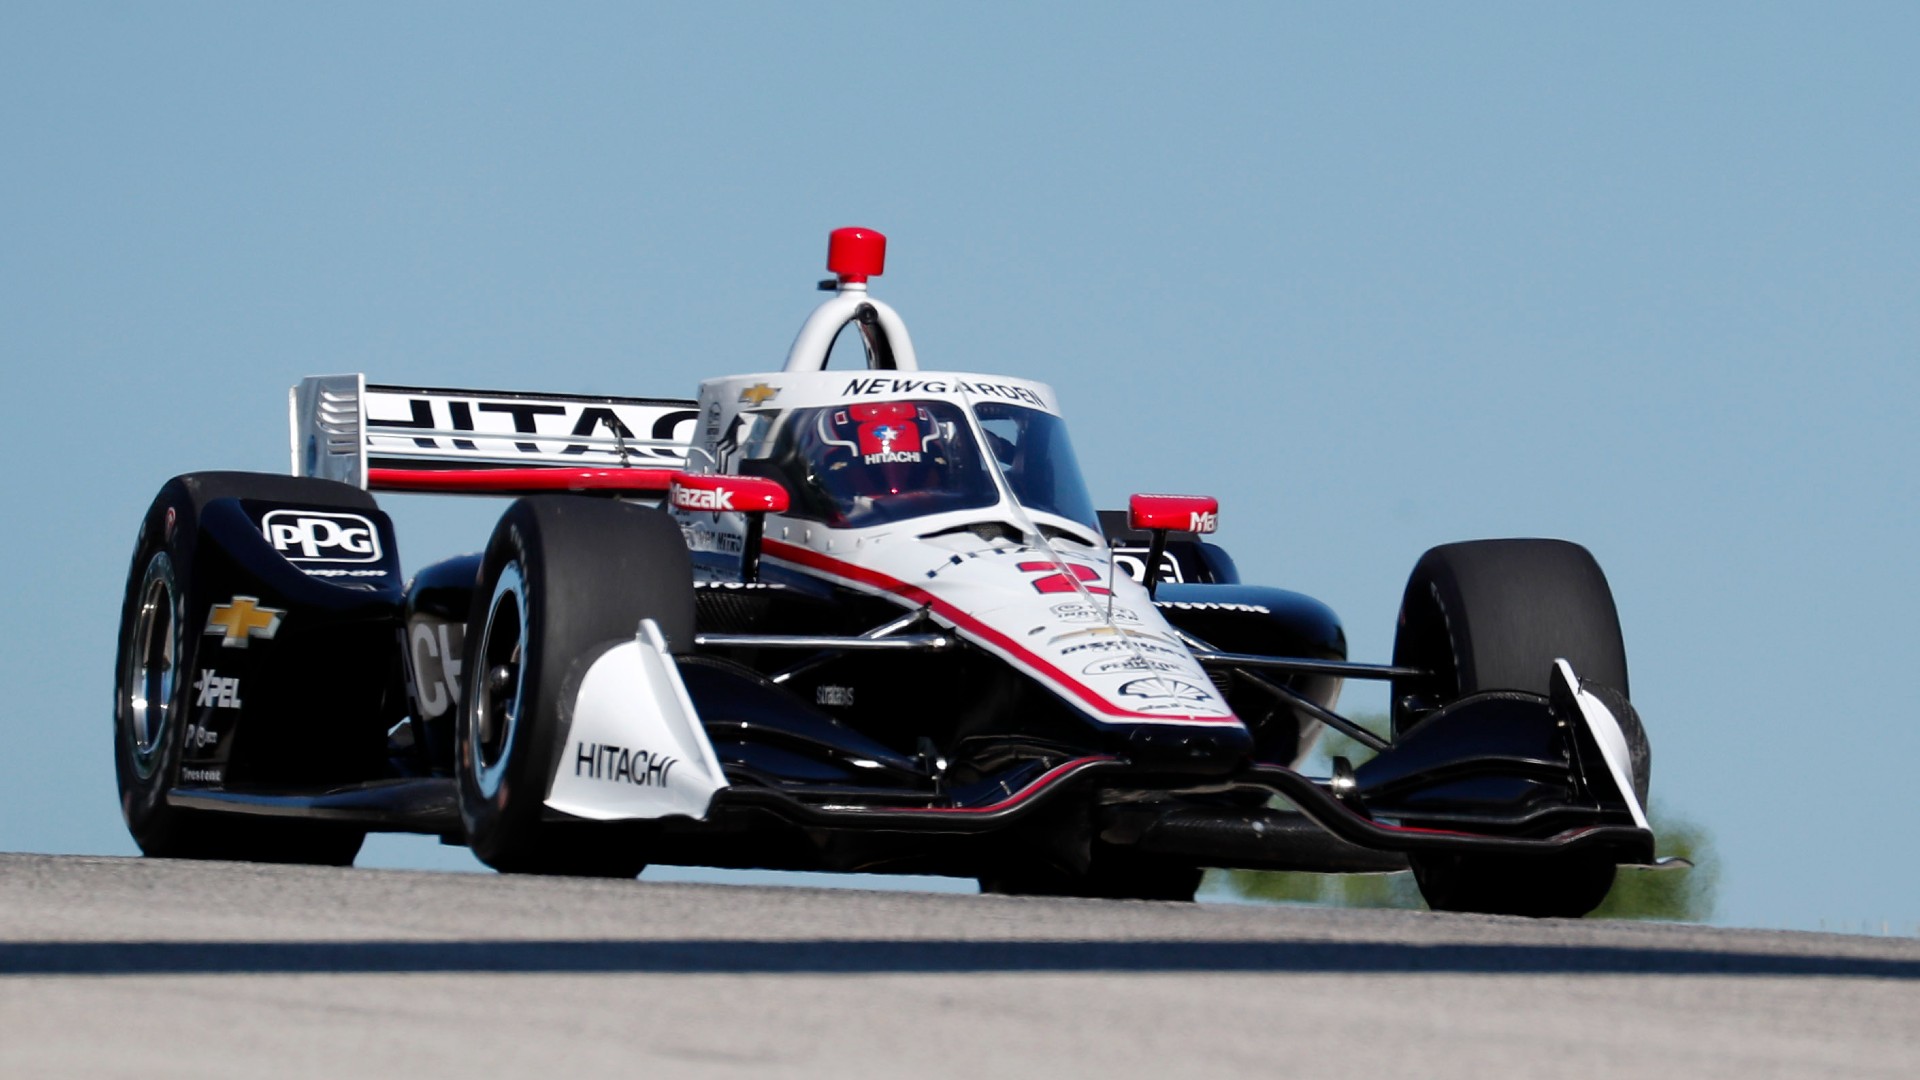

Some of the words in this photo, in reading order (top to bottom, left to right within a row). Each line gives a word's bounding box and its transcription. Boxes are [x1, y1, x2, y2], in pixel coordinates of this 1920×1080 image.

[842, 378, 1048, 409] NEWGARDEN
[865, 451, 921, 465] HITACHI
[270, 518, 373, 557] PPG
[1016, 560, 1117, 598] 2
[193, 668, 242, 709] XPEL
[576, 741, 678, 788] HITACHI
